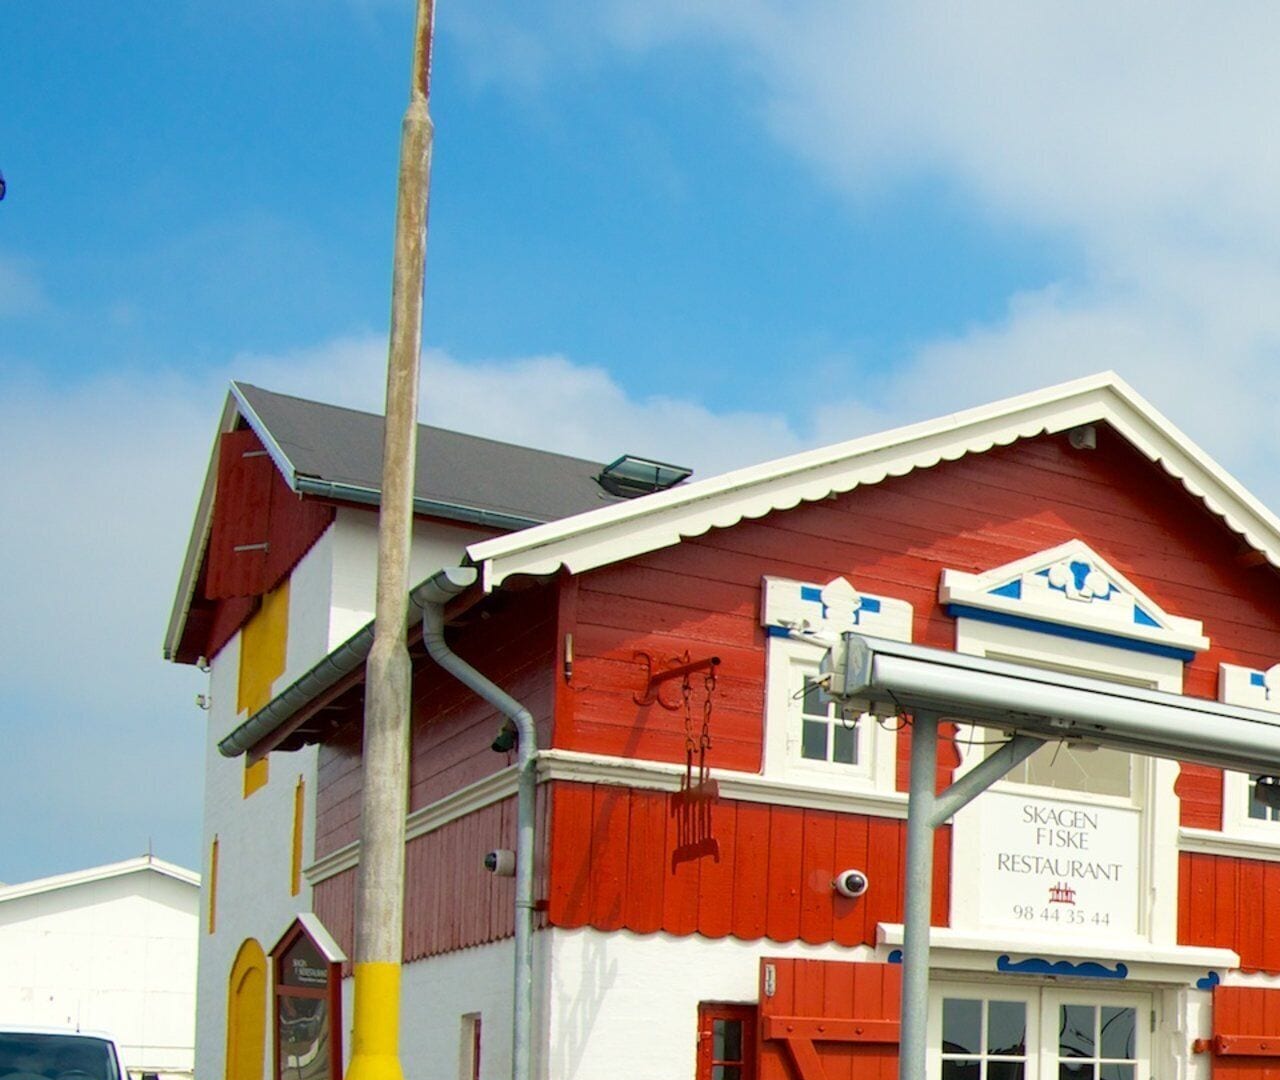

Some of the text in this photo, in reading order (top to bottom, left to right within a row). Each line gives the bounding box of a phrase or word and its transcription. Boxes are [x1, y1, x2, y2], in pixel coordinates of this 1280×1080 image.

[1022, 804, 1098, 830] SKAGEN
[1036, 827, 1089, 850] FISKE
[998, 852, 1123, 881] RESTAURANT
[1012, 904, 1111, 927] 98 44 35 44
